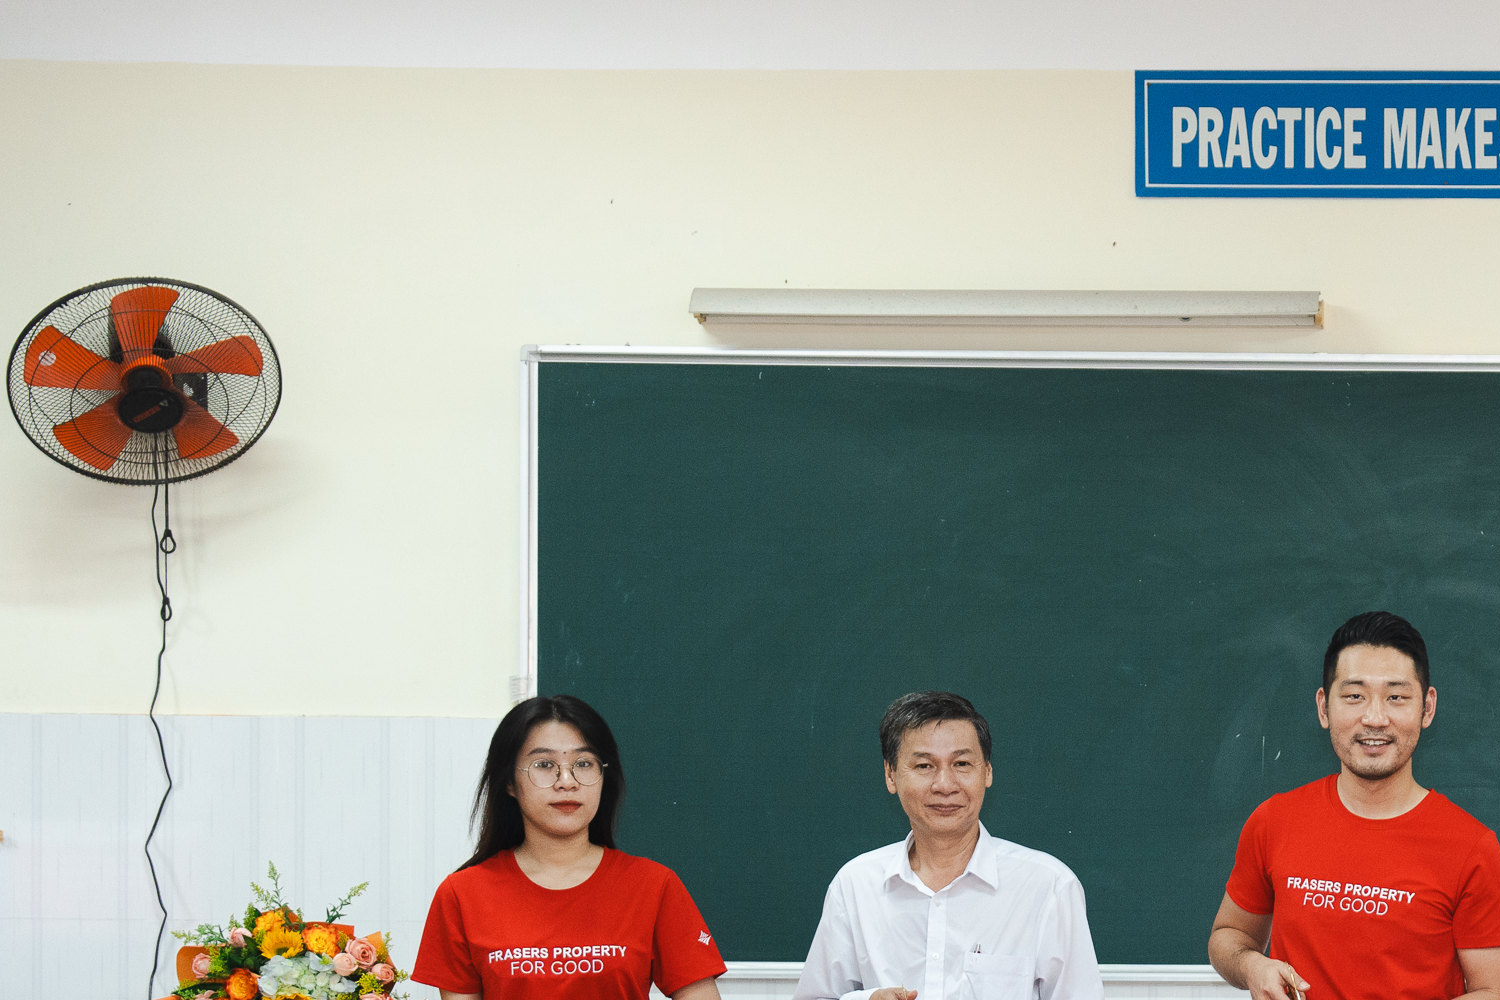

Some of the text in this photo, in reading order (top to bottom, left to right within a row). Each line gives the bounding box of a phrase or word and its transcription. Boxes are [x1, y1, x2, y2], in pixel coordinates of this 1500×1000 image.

[1172, 106, 1367, 169] PRACTICE
[1286, 876, 1416, 904] FRASERS PROPERTY
[1303, 892, 1389, 916] FOR GOOD
[488, 945, 627, 964] FRASERS PROPERTY
[510, 958, 604, 976] FOR GOOD
